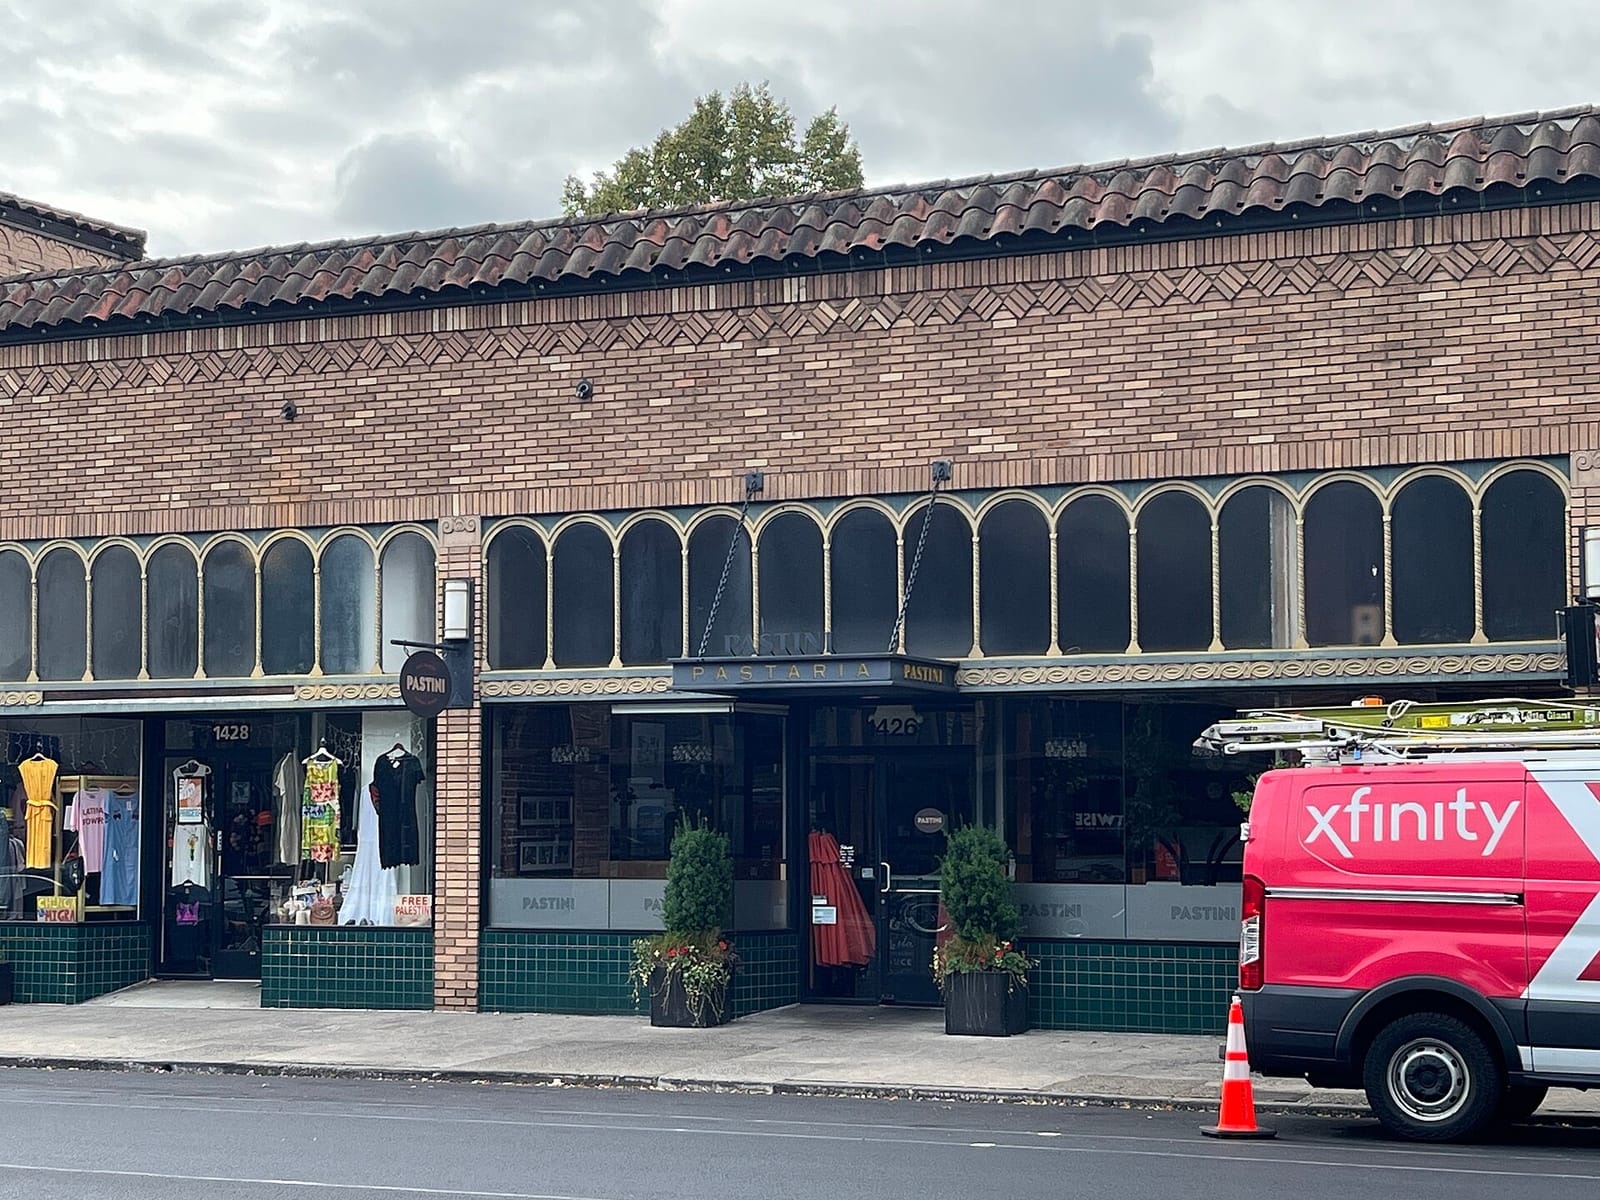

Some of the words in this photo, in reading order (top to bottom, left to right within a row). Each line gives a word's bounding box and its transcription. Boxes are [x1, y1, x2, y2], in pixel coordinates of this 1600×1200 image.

[692, 663, 870, 681] PASTARIA
[903, 664, 943, 683] PASTINI
[406, 674, 446, 694] PASTINI
[213, 725, 249, 741] 1428
[1304, 786, 1521, 858] xfinity
[401, 896, 429, 906] FREE
[522, 897, 575, 912] PASTINI
[1020, 902, 1082, 919] PASTINI
[1170, 905, 1236, 921] PASTINI
